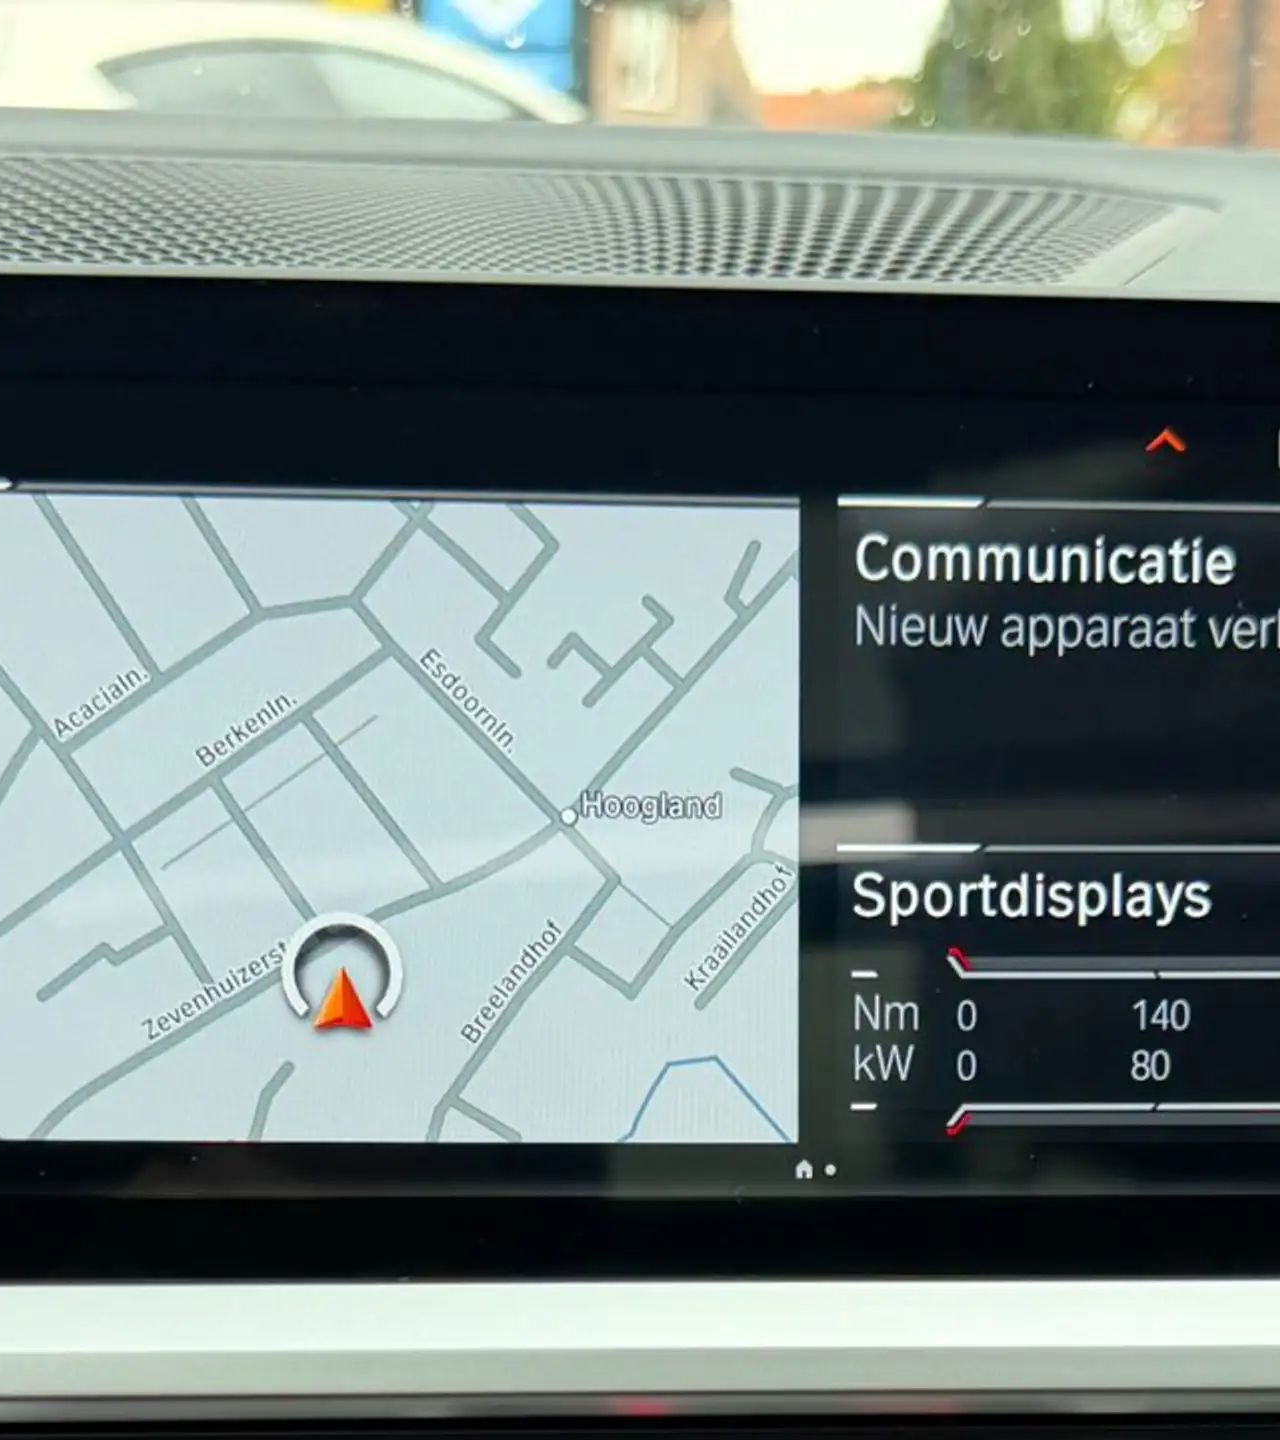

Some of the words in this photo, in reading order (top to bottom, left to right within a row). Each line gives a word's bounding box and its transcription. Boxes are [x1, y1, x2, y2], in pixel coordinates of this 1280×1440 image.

[856, 532, 1236, 585] Communicatie
[856, 603, 989, 647] Nieuw
[1001, 609, 1196, 657] apparaat
[52, 666, 149, 739] Acacialn.
[420, 647, 516, 753] Esdoornln.
[195, 694, 298, 768] Berkenln.
[580, 790, 722, 824] Hoogland
[853, 870, 1212, 927] Sportdisplays
[684, 864, 793, 992] Kraailandhof
[460, 918, 562, 1044] Breelandhof
[854, 993, 919, 1031] Nm
[957, 999, 977, 1032] 0
[1133, 998, 1191, 1031] 140
[854, 1044, 915, 1081] kW
[957, 1049, 977, 1082] 0
[1130, 1049, 1171, 1081] 80
